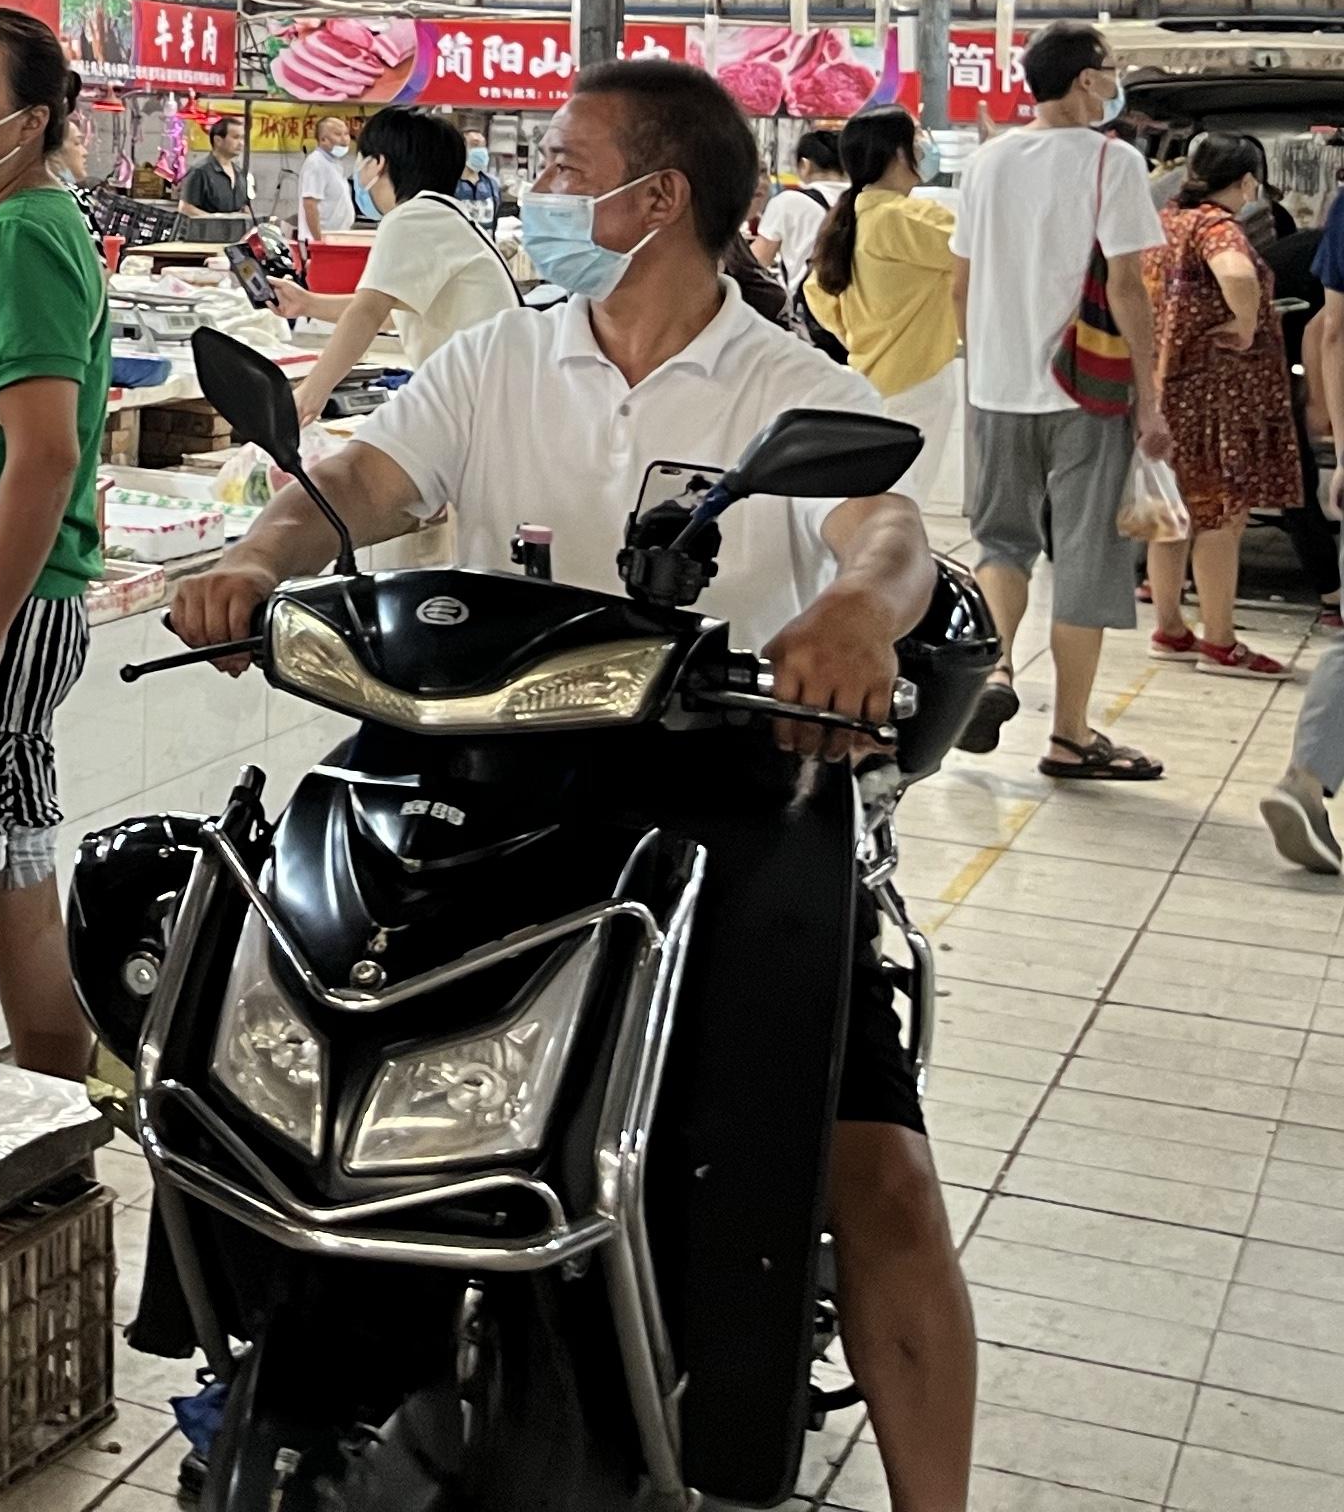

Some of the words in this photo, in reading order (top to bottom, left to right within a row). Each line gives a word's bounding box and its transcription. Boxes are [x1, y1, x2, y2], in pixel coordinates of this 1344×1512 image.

[154, 7, 218, 67] 牛羊肉
[436, 31, 671, 84] 简阳山
